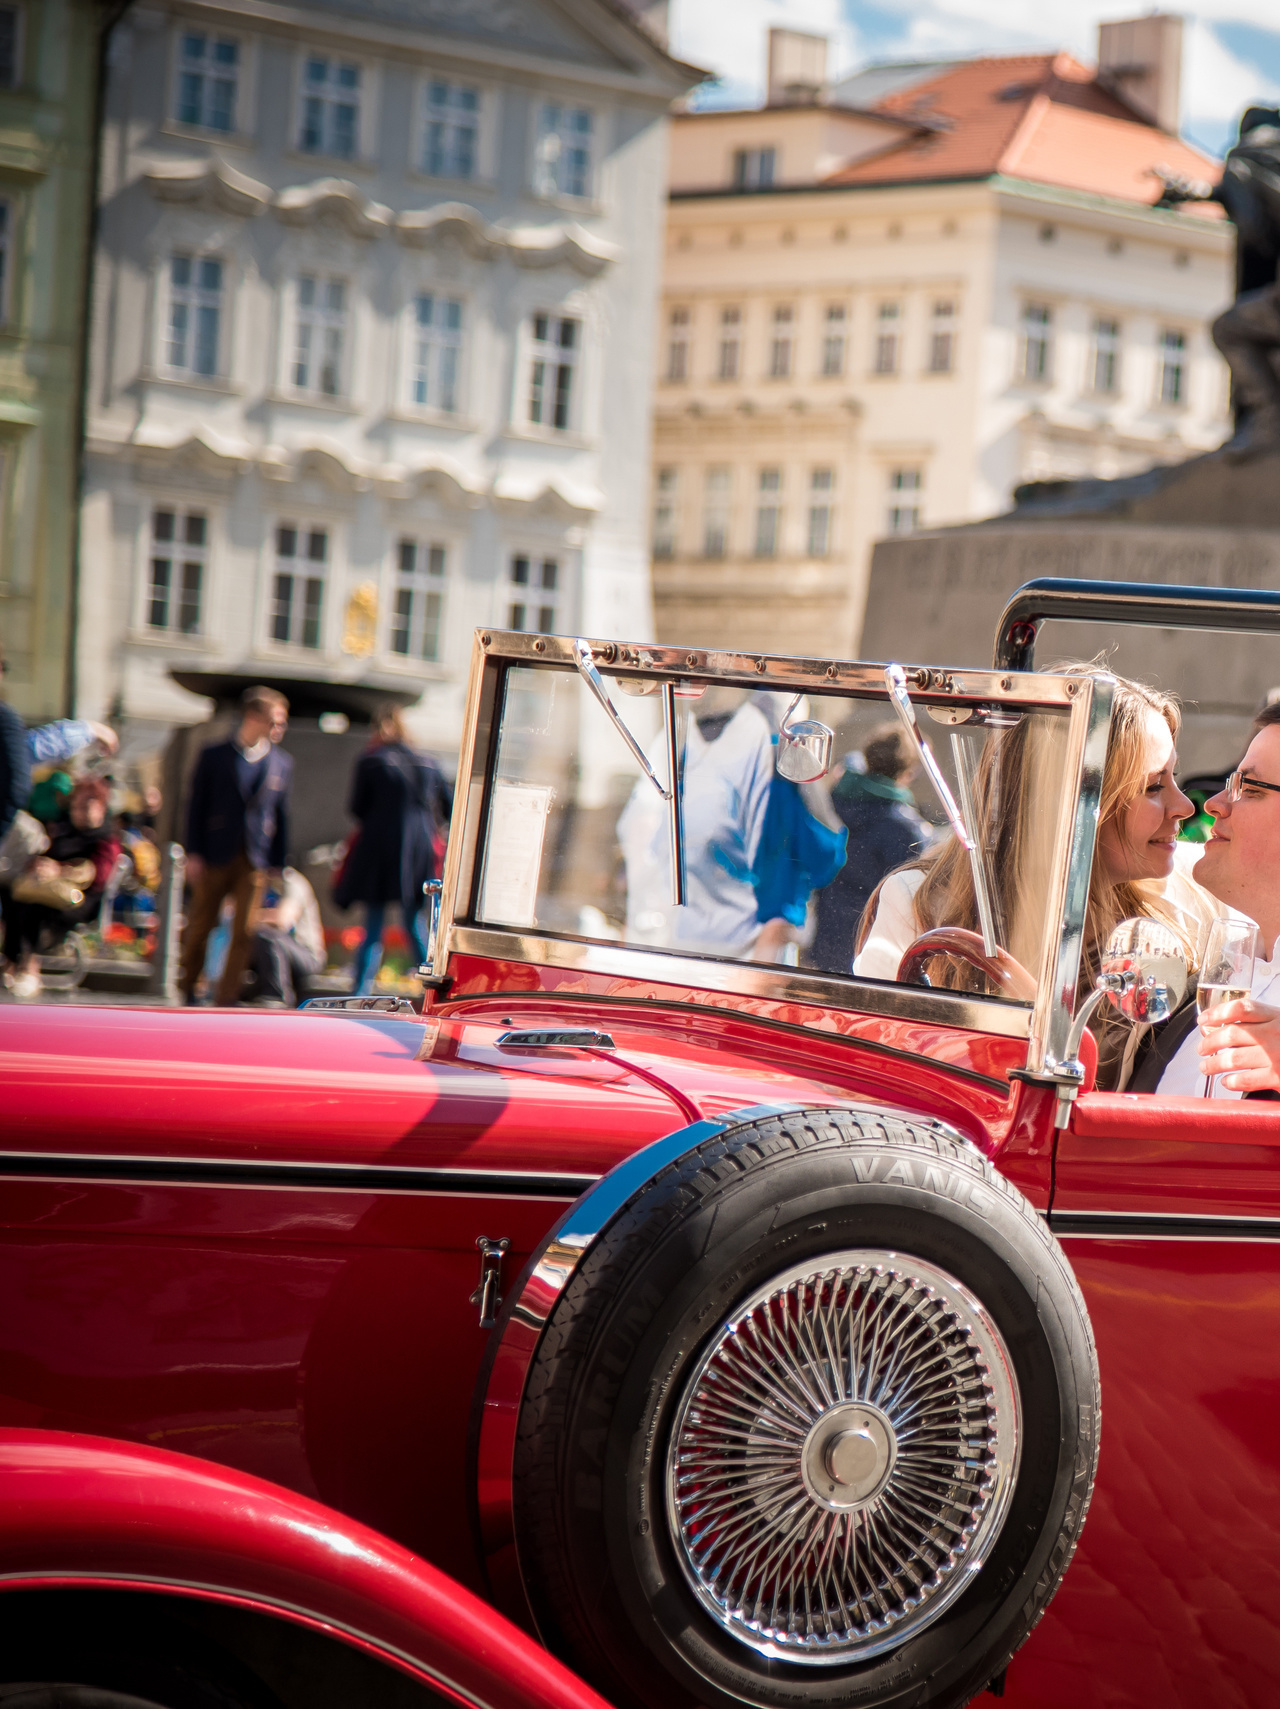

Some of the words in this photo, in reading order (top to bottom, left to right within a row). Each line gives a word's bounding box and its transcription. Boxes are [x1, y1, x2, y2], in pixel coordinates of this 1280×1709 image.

[850, 1157, 995, 1219] VANIS
[575, 1281, 665, 1508] BARUM
[1022, 1405, 1091, 1621] BARUM
